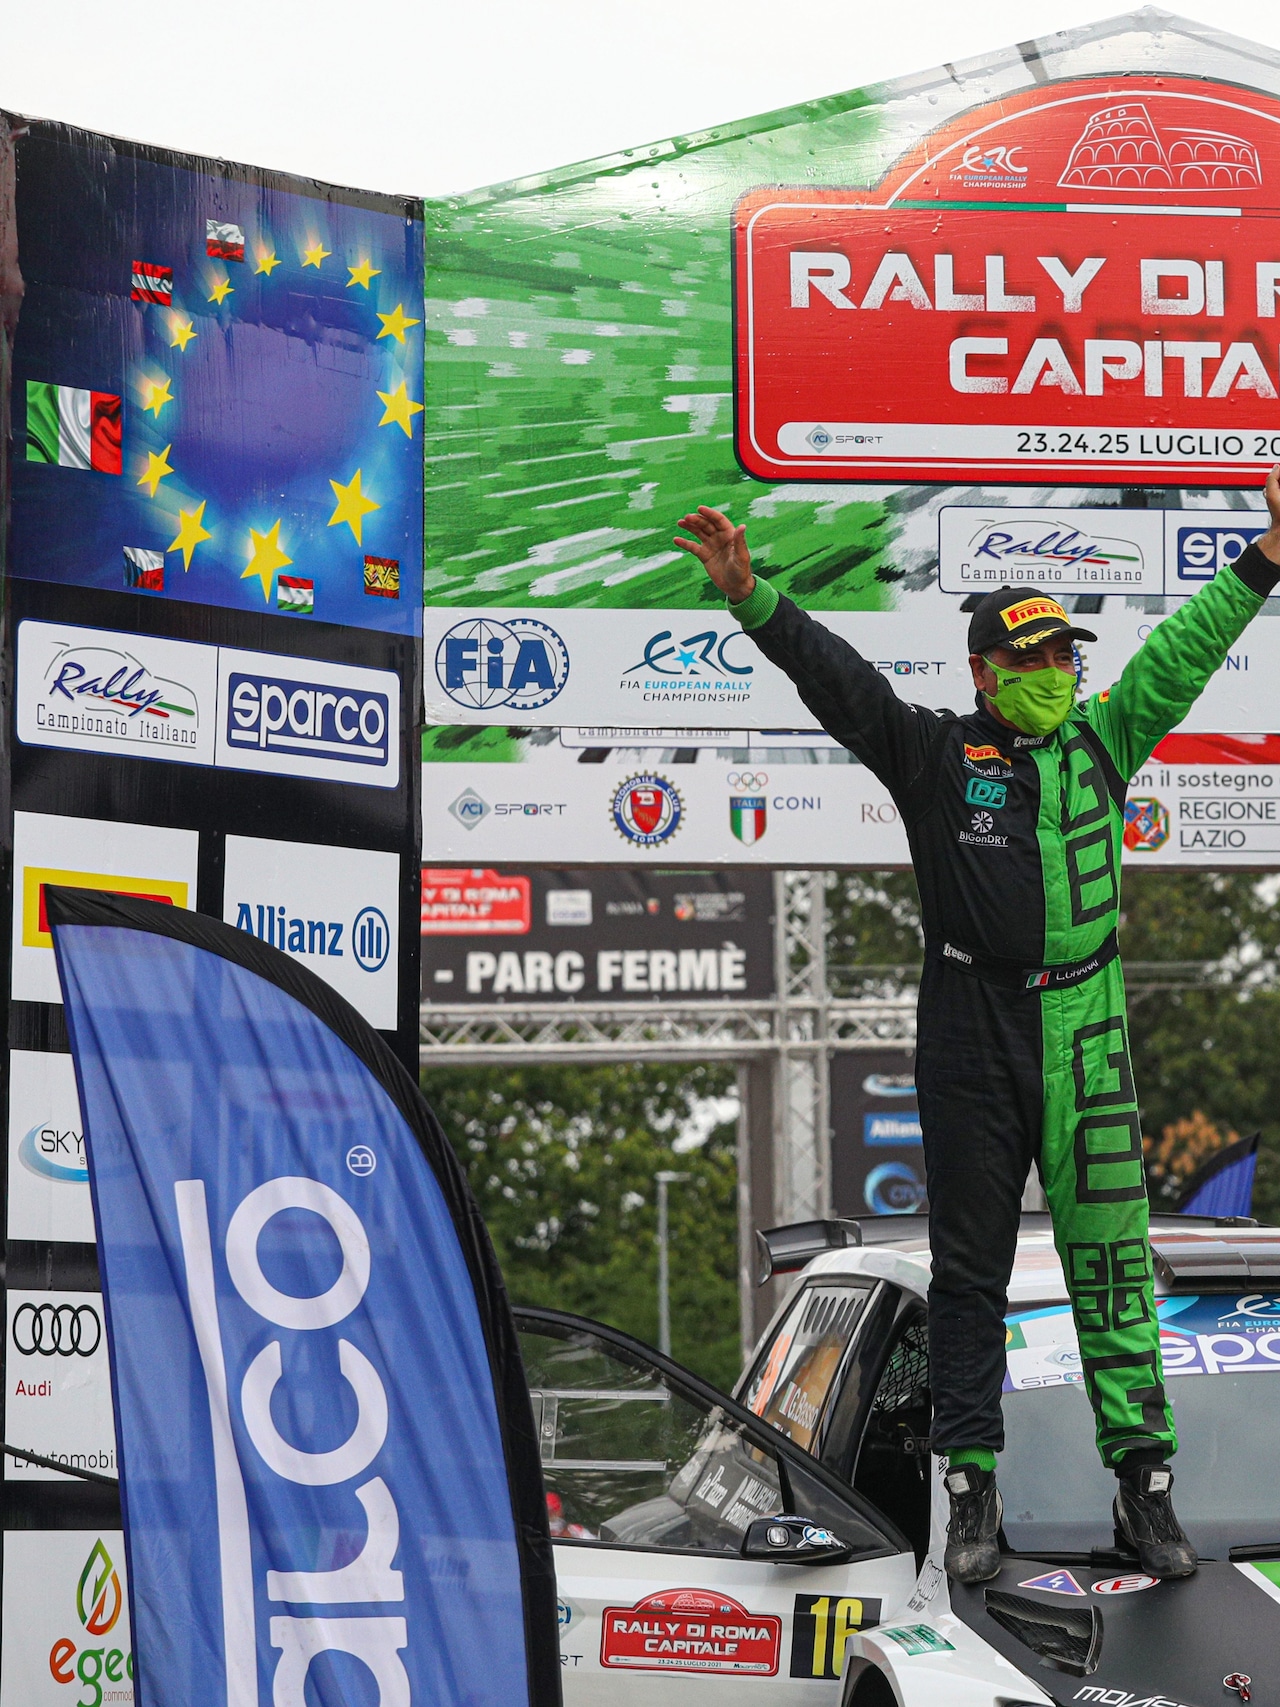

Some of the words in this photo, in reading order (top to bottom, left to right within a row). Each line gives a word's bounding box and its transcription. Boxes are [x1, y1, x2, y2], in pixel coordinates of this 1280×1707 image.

[963, 181, 1027, 189] CHAMPIONSHIP
[790, 252, 1106, 313] RALLY
[1141, 260, 1223, 316] DI
[835, 434, 884, 444] SPORT
[1017, 432, 1130, 454] 23.24.25
[1139, 434, 1244, 457] LUGLIO
[974, 530, 1103, 567] Rally
[961, 563, 1062, 583] Campionato
[1076, 567, 1143, 582] Italiano
[870, 660, 947, 675] PORT
[49, 661, 164, 717] Rally
[620, 680, 641, 690] FIA
[644, 680, 711, 691] EUROPEAN
[714, 681, 752, 691] RALLY
[642, 692, 751, 702] CHAMPIONSHIP
[231, 681, 385, 748] sparco
[37, 704, 127, 737] Campionato
[140, 720, 197, 745] Italiano
[1128, 772, 1153, 788] on
[1159, 769, 1170, 788] il
[1177, 772, 1275, 794] sostegno
[613, 775, 657, 813] AUTOMOBILE
[666, 787, 681, 813] CLUB
[459, 803, 483, 815] ACI
[494, 803, 568, 816] SPORT
[732, 799, 766, 809] ITALIA
[773, 797, 822, 810] CONI
[1179, 802, 1276, 820] REGIONE
[631, 834, 663, 844] ROMA
[1179, 830, 1247, 848] LAZIO
[943, 942, 973, 965] freem
[466, 951, 585, 994] PARC
[15, 1380, 52, 1396] Audi
[613, 1619, 681, 1637] RALLY
[686, 1624, 705, 1637] DI
[710, 1625, 771, 1641] ROMA
[809, 1596, 864, 1677] 16
[644, 1638, 739, 1656] CAPITALE
[683, 1659, 706, 1667] LUGLIO
